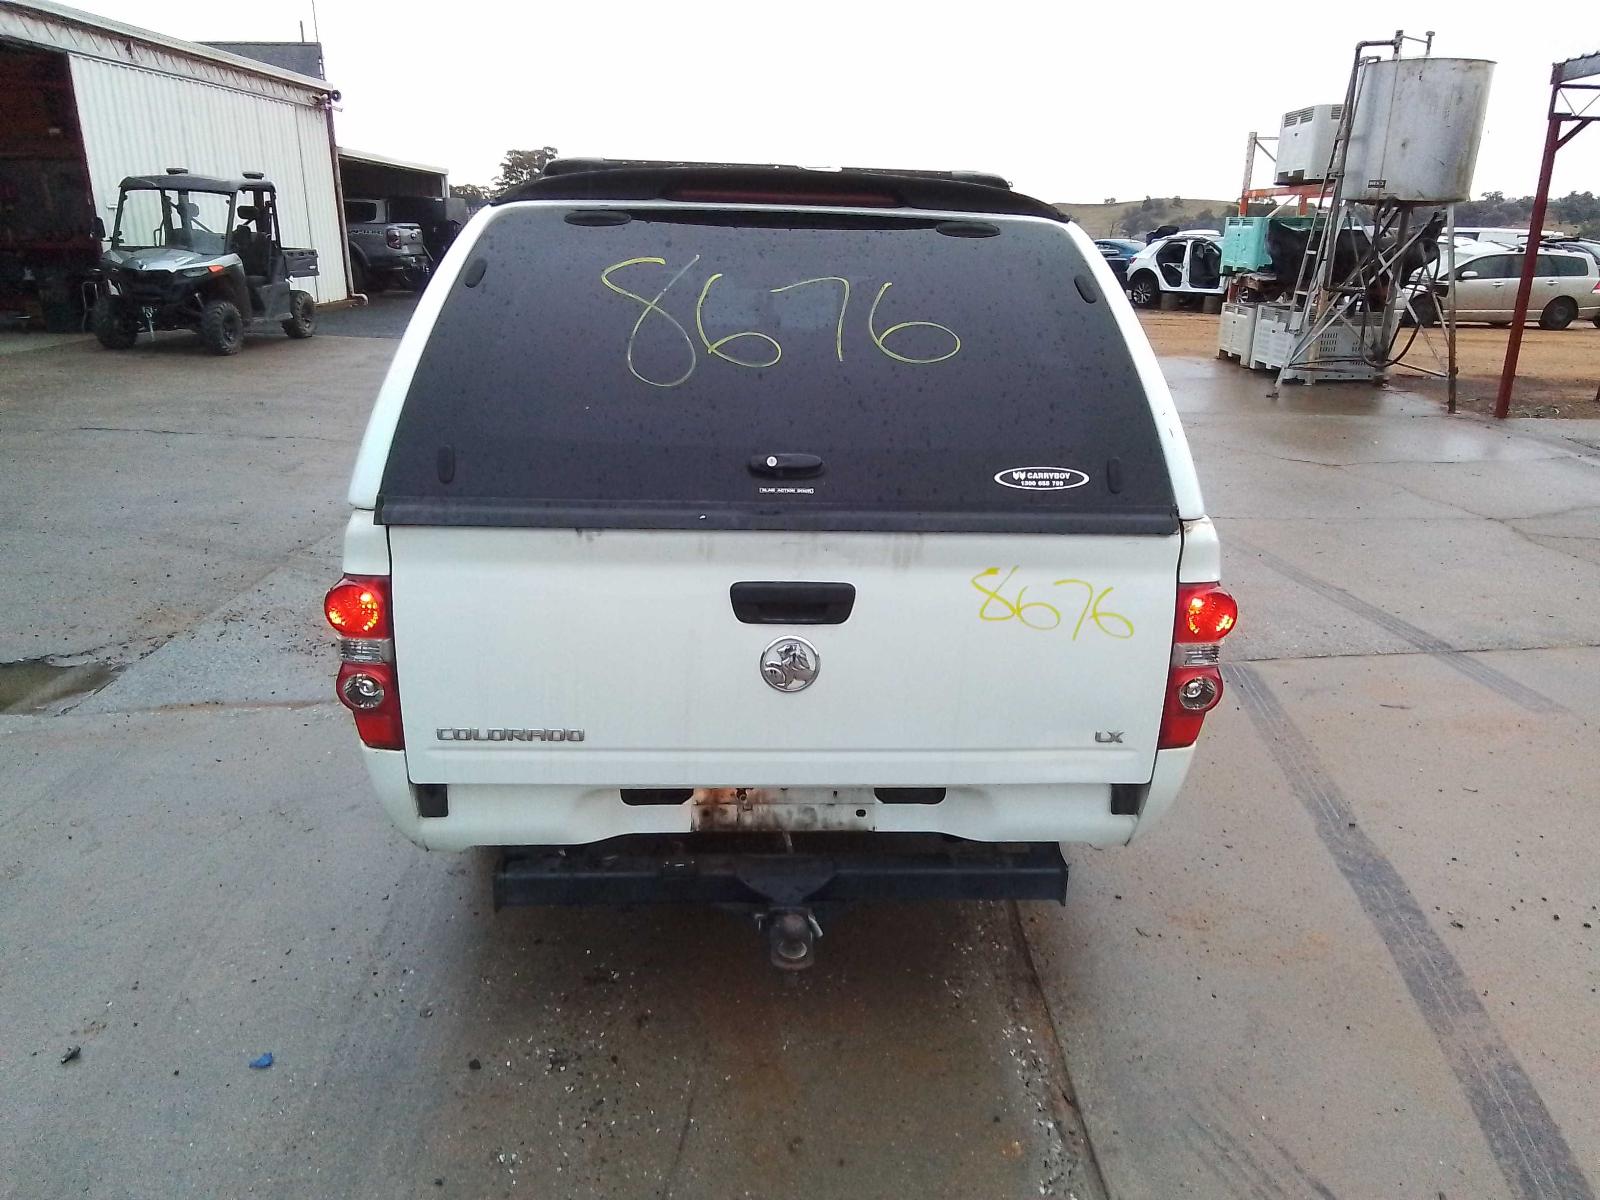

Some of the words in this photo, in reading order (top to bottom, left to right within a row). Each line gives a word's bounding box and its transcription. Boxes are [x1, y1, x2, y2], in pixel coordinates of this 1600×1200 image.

[601, 254, 961, 387] 8676
[1026, 471, 1070, 479] CARRYBOY
[970, 564, 1135, 641] 8676
[436, 727, 585, 742] COLORADO
[1095, 731, 1125, 743] LX
